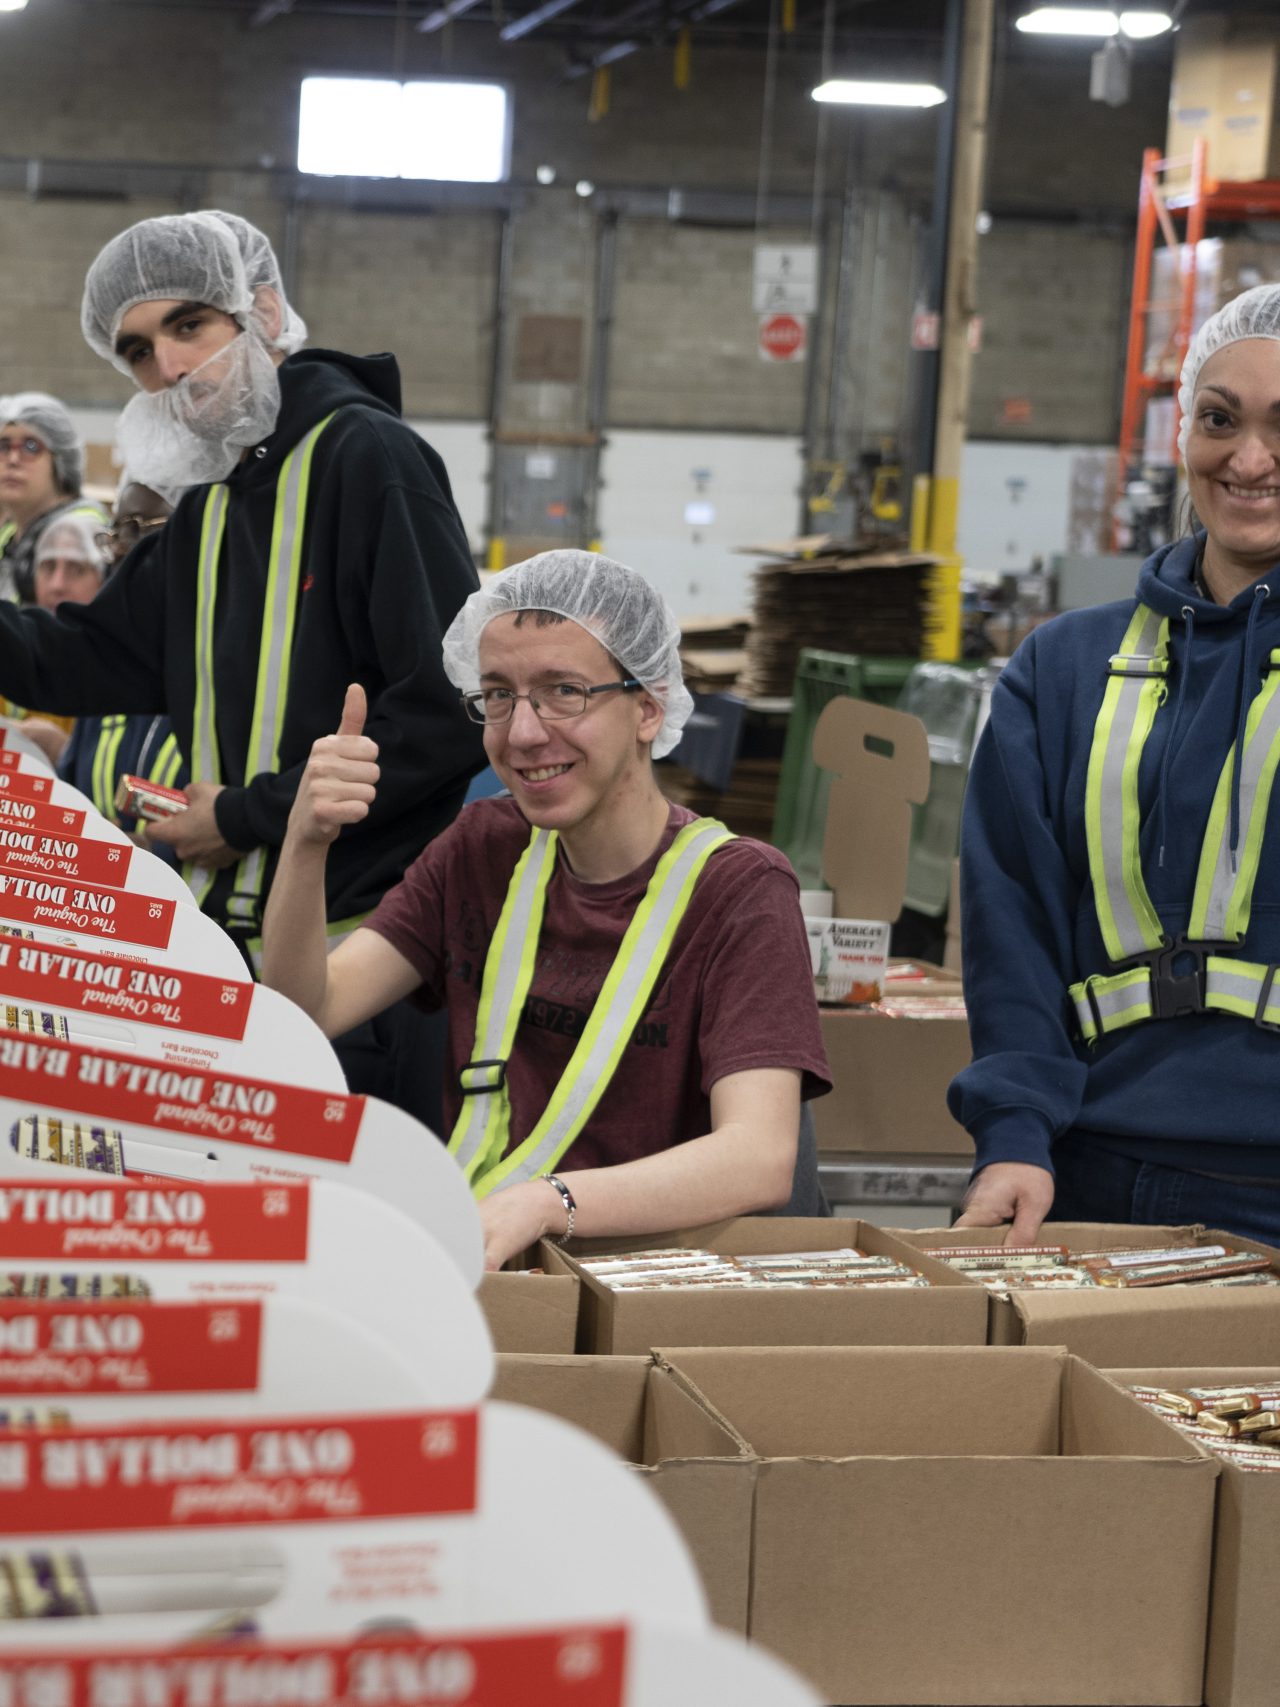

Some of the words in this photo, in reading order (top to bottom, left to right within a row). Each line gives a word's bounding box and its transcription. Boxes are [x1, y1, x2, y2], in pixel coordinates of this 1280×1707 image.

[0, 798, 36, 820] ONE
[5, 845, 54, 871] Original
[40, 836, 79, 860] ONE
[107, 852, 121, 862] 60
[56, 859, 79, 876] The
[34, 899, 89, 929] Original
[73, 888, 116, 916] ONE
[148, 907, 162, 920] 60
[92, 915, 116, 934] The
[832, 935, 875, 949] VARIETY
[19, 946, 123, 989] DOLLAR
[128, 967, 181, 1001] ONE
[81, 982, 148, 1017] Original
[220, 990, 237, 1006] 60
[150, 1000, 181, 1024] The
[161, 1041, 179, 1052] Bars
[181, 1045, 219, 1059] Chocolate
[164, 1052, 211, 1069] Fundraising
[79, 1052, 204, 1103] DOLLAR
[213, 1078, 277, 1118] ONE
[155, 1095, 235, 1135] Original
[238, 1116, 275, 1143] The
[124, 1190, 205, 1224] ONE
[64, 1223, 162, 1252] Original
[166, 1228, 211, 1255] The
[50, 1315, 143, 1352] ONE
[97, 1359, 149, 1387] The
[43, 1432, 237, 1486] DOLLAR
[250, 1427, 352, 1479] ONE
